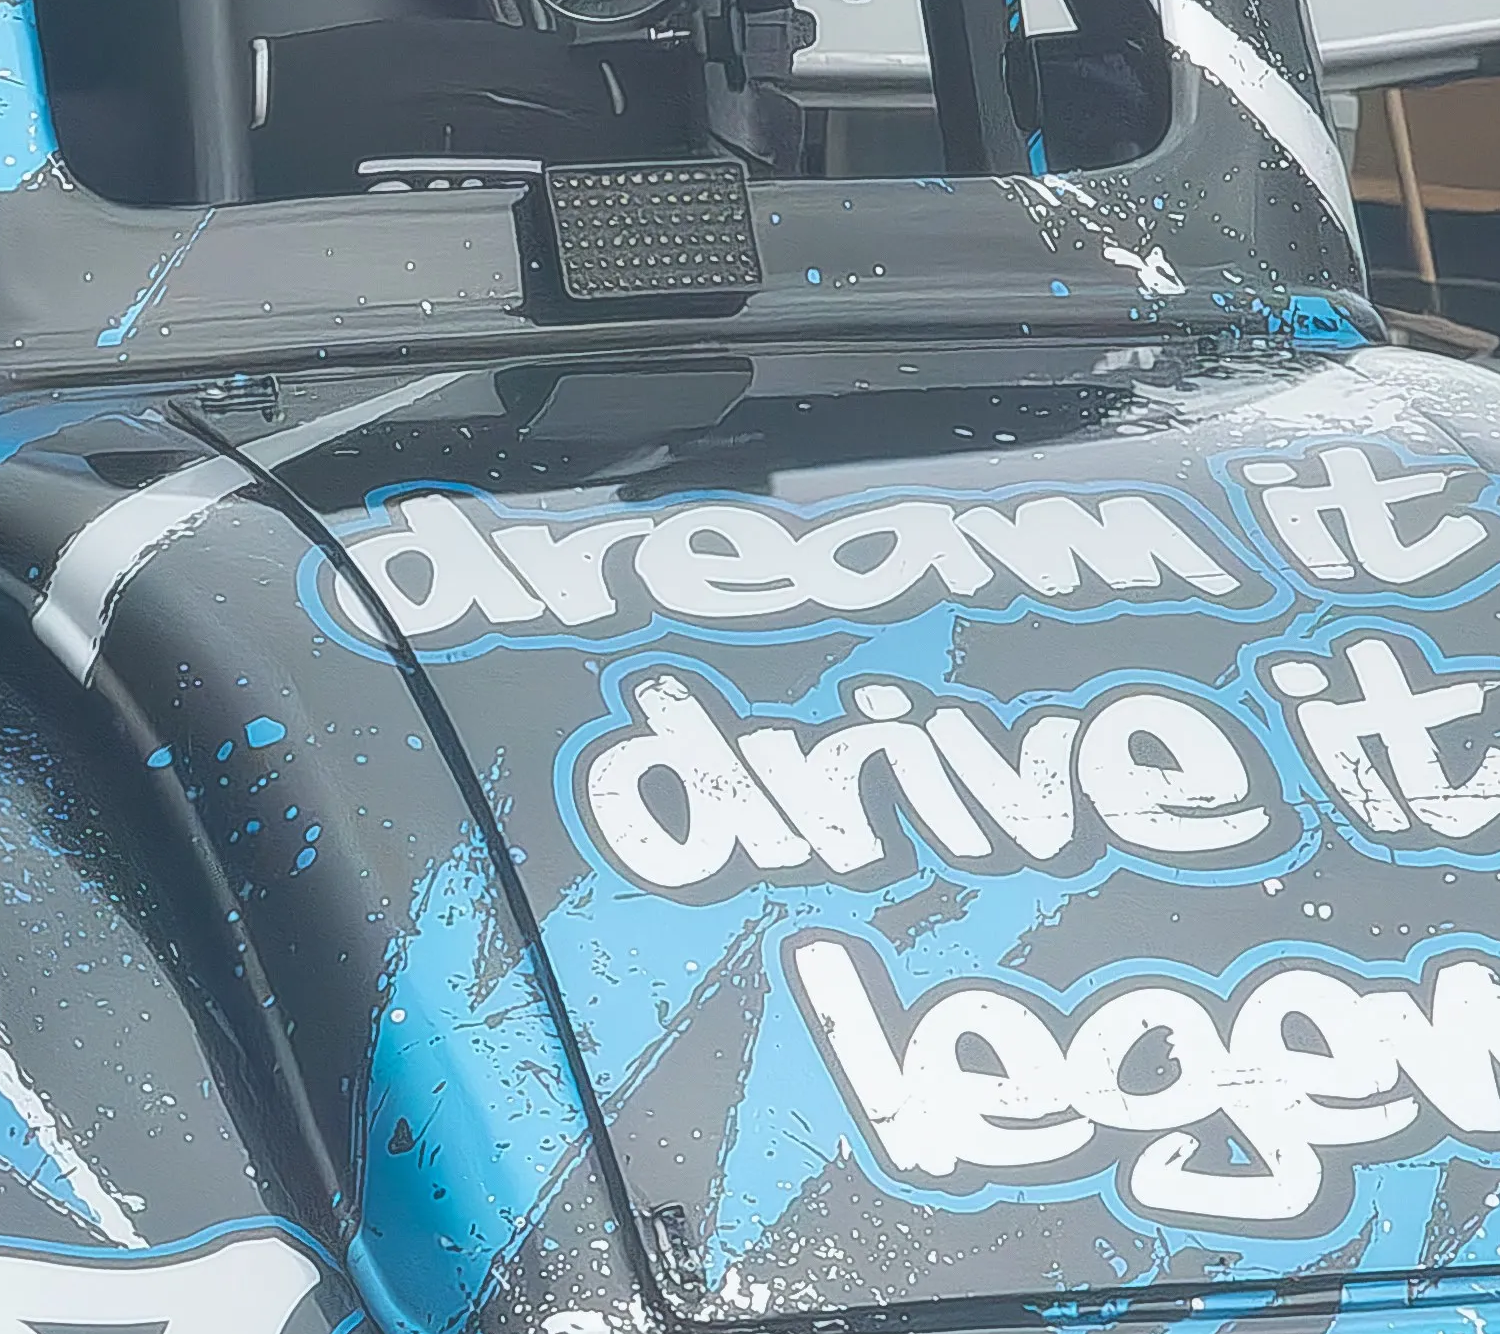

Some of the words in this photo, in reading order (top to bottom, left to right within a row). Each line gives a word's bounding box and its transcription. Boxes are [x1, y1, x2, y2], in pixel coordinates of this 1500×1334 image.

[338, 493, 1242, 642] dream
[1243, 444, 1487, 582] it
[586, 675, 1272, 888] drive
